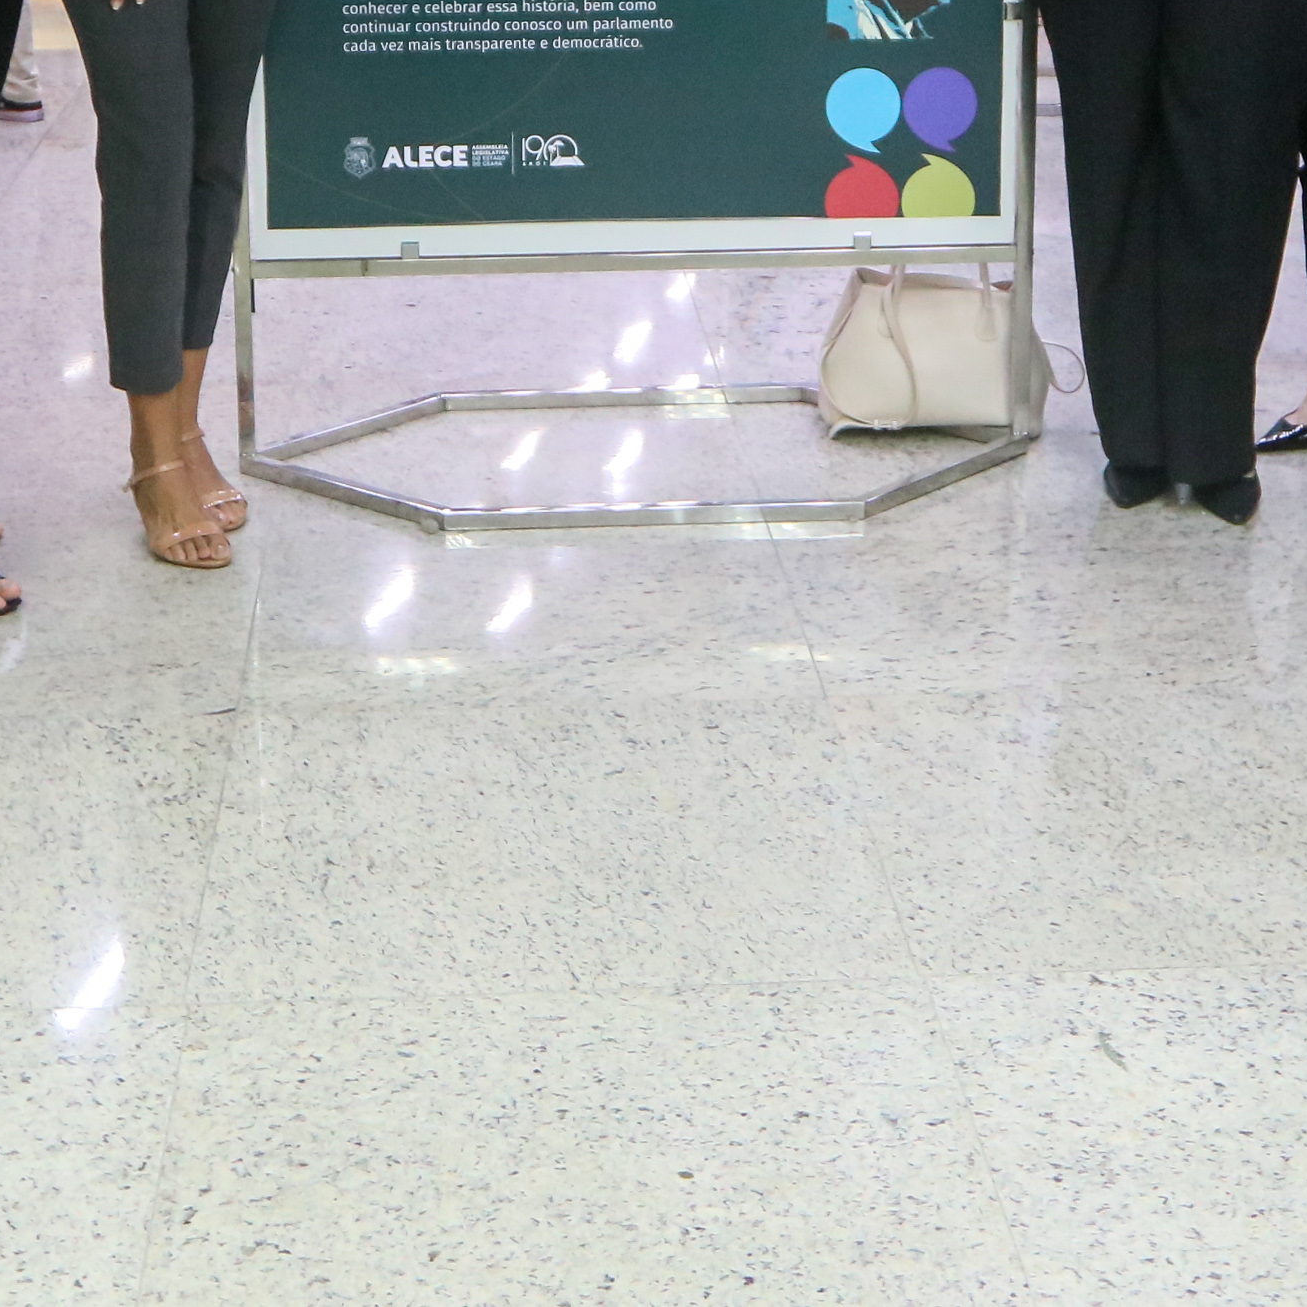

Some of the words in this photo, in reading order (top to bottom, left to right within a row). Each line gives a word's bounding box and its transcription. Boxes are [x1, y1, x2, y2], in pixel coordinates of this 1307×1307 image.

[342, 1, 408, 15] conhecer
[412, 4, 420, 14] e
[424, 0, 483, 14] celebrar
[486, 2, 518, 13] essa
[522, 0, 579, 14] história,
[584, 0, 614, 14] bem
[618, 1, 657, 11] como
[342, 19, 411, 34] continuar
[415, 18, 500, 33] construindo
[504, 20, 562, 32] conosco
[566, 20, 589, 31] um
[593, 17, 674, 33] parlamento
[343, 39, 377, 53] cada
[380, 41, 404, 53] vez
[408, 38, 442, 52] mais
[445, 38, 536, 53] transparente
[540, 39, 549, 50] e
[552, 36, 643, 52] democrático.
[381, 145, 469, 168] ALECE
